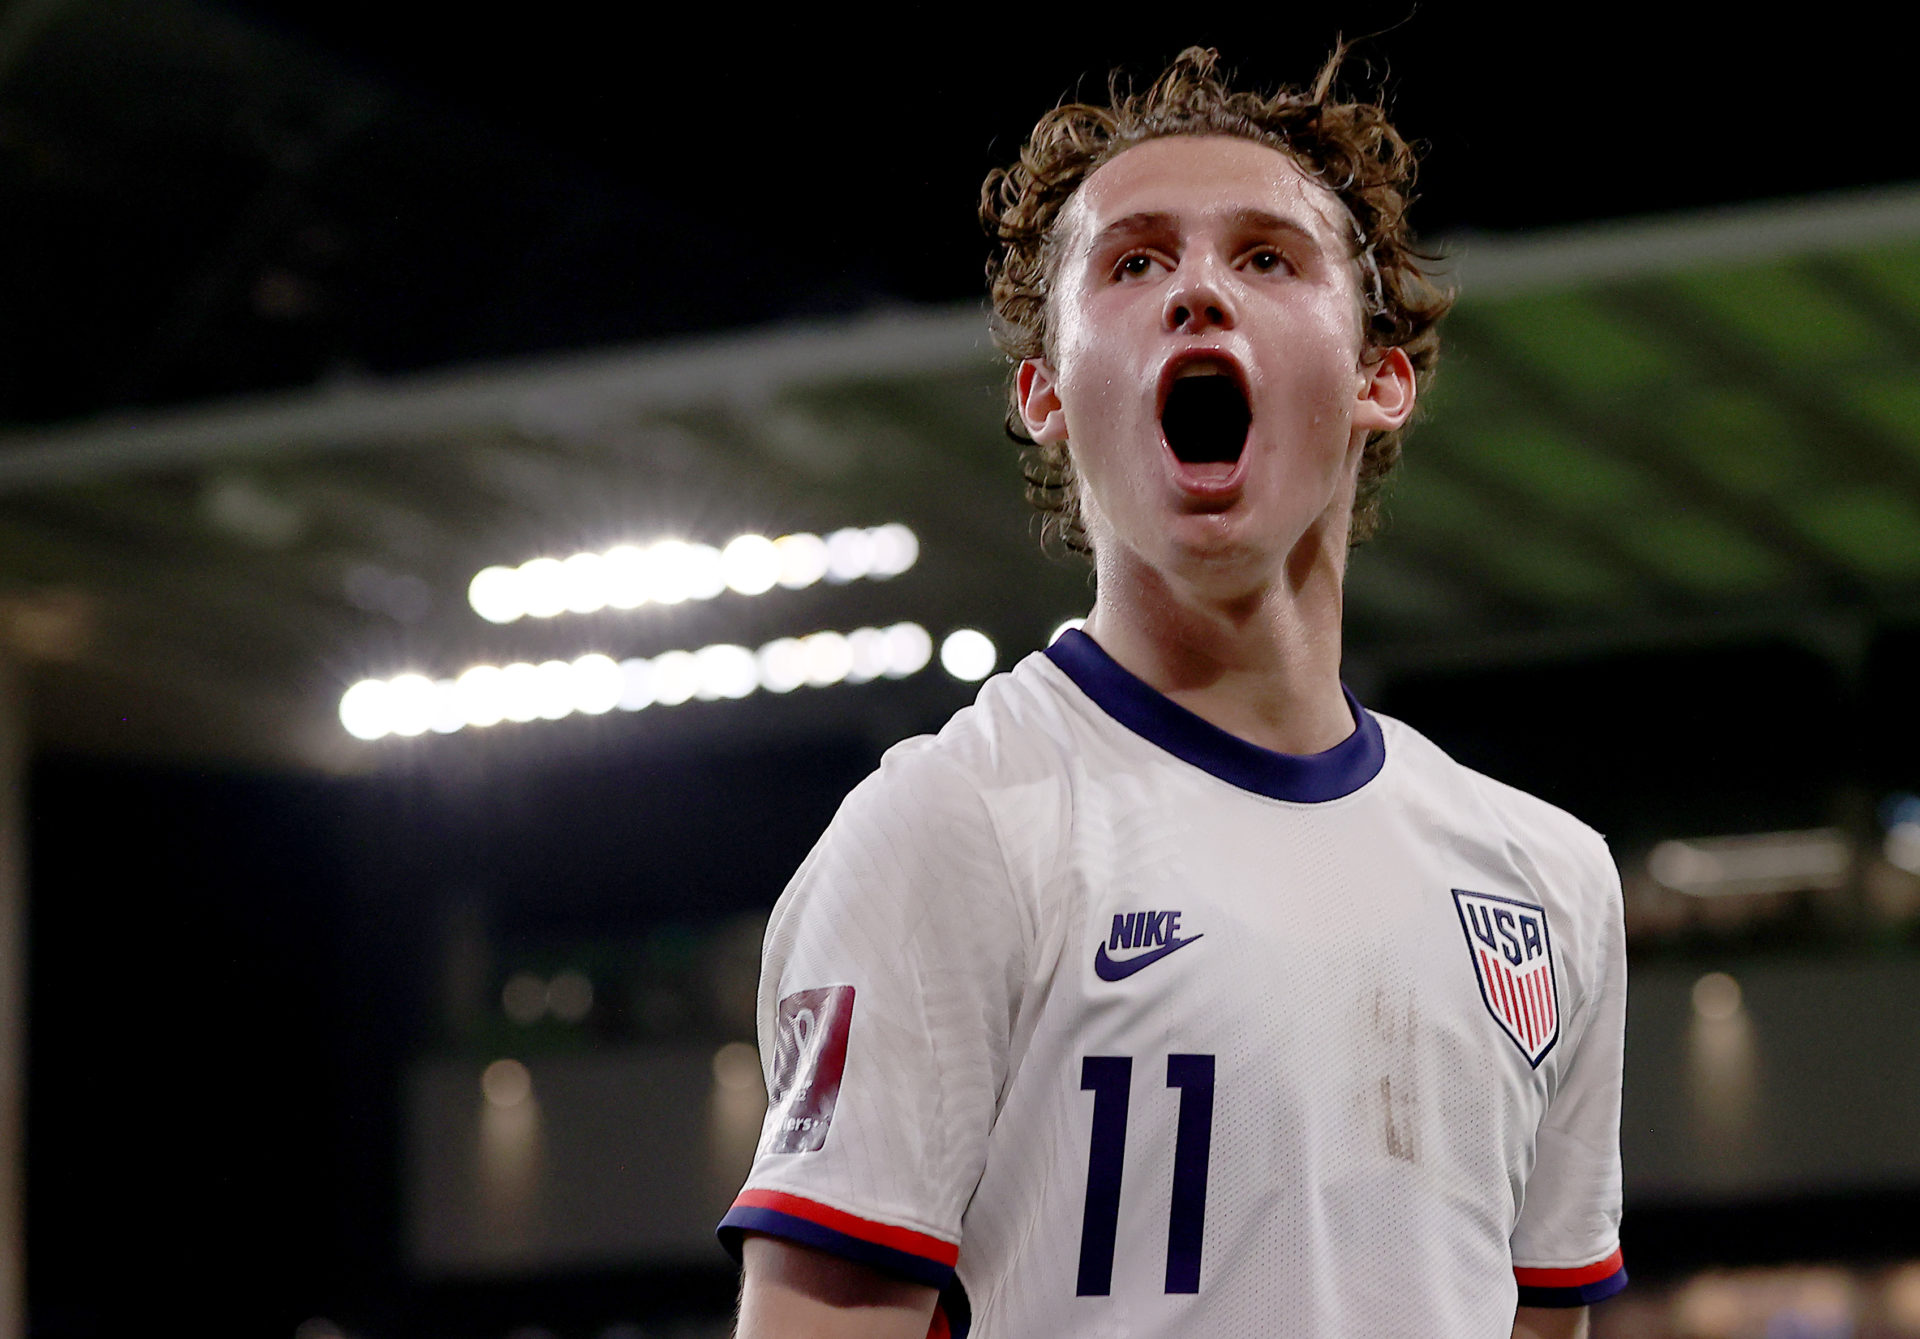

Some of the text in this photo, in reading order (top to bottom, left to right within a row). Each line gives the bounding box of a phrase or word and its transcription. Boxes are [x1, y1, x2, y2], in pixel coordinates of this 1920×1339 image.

[1109, 911, 1181, 950] NIKE
[1467, 903, 1542, 966] USA
[1077, 1054, 1215, 1297] 11
